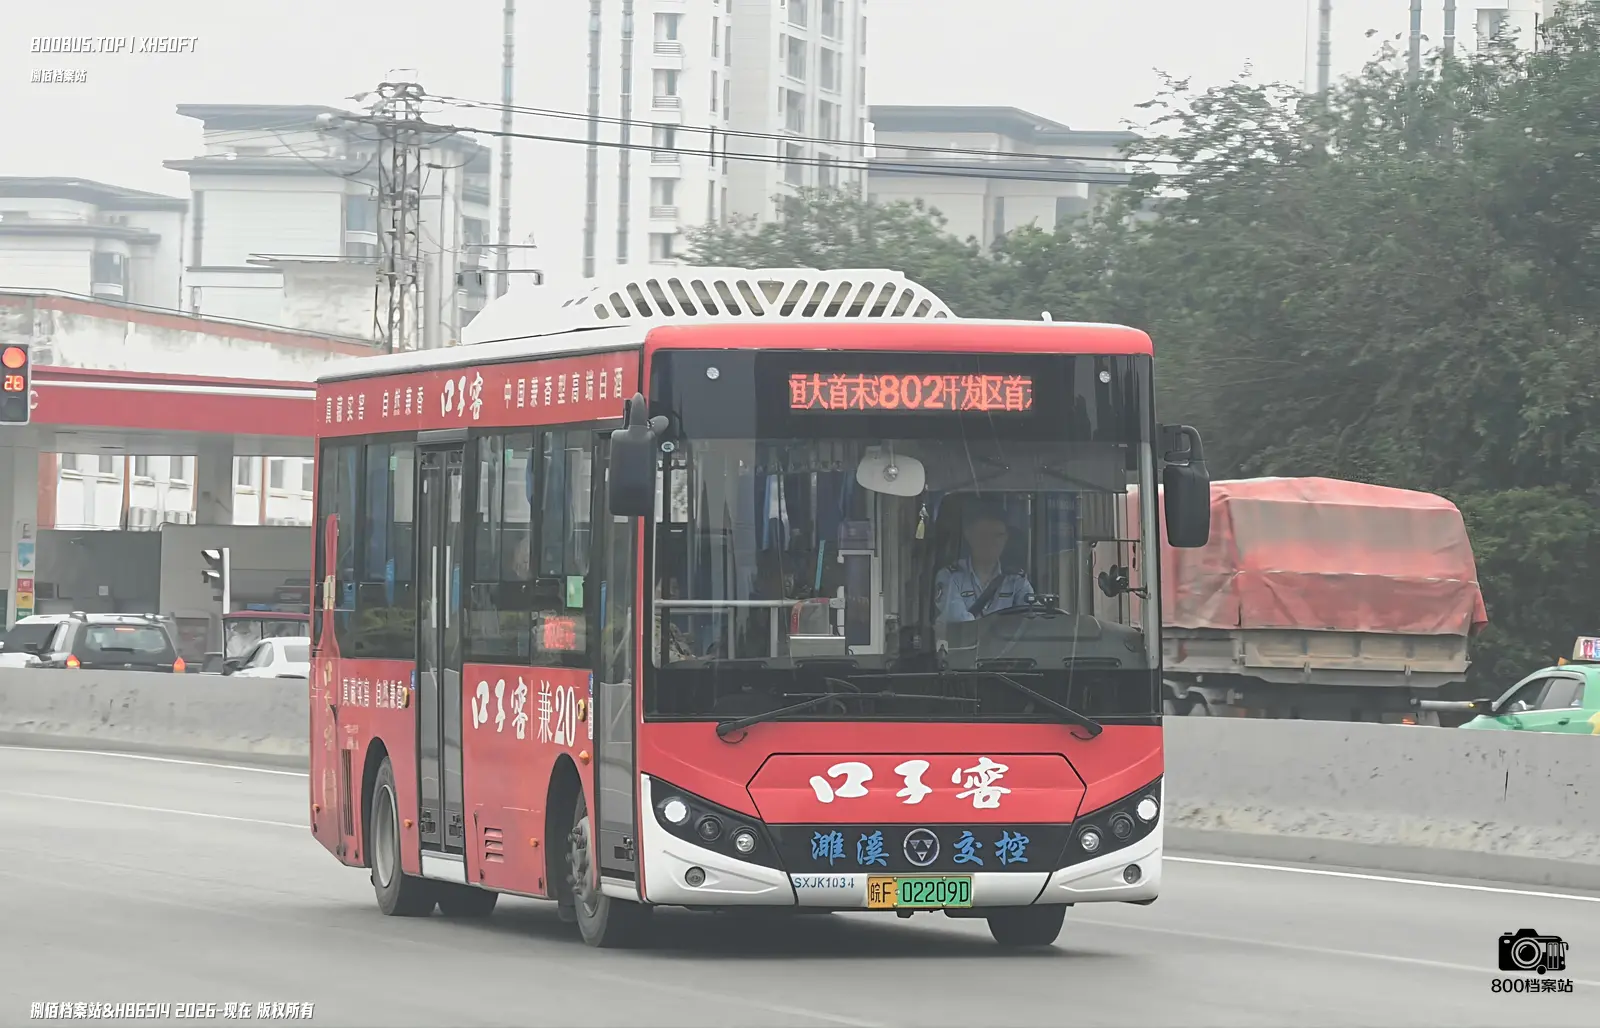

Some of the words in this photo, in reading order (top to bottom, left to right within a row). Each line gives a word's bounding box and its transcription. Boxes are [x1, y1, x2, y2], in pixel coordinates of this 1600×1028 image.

[471, 676, 529, 740] 口子窖
[809, 756, 1011, 809] 口子窖
[953, 830, 1030, 867] 交控
[793, 876, 854, 889] SXJK1034
[870, 882, 893, 904] 皖F
[902, 881, 969, 904] 02209D
